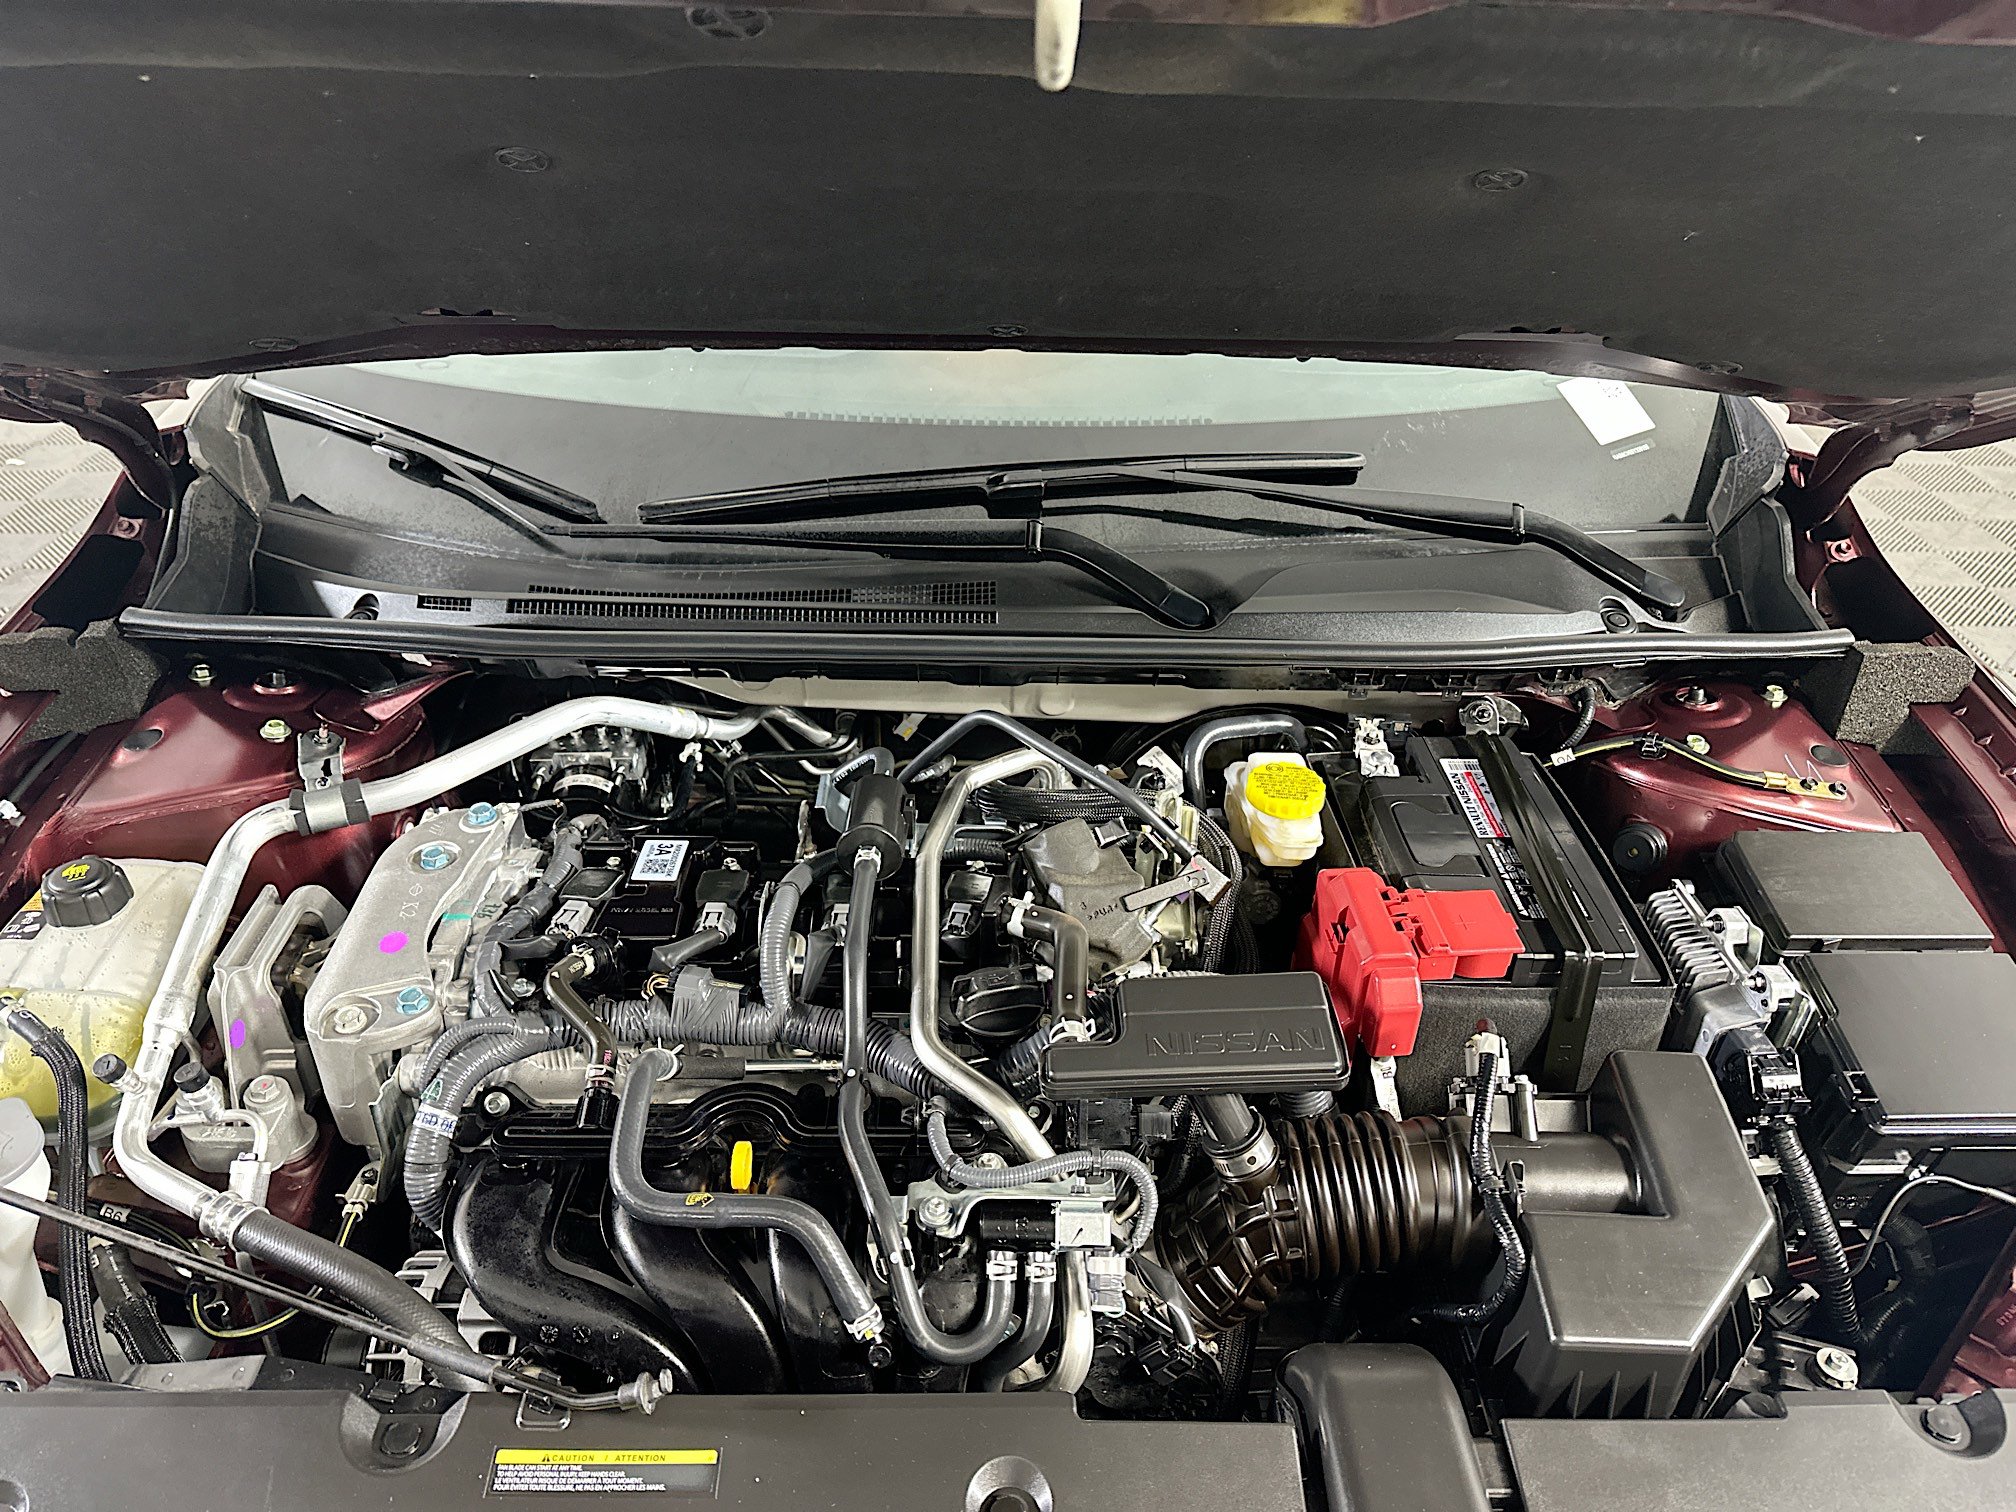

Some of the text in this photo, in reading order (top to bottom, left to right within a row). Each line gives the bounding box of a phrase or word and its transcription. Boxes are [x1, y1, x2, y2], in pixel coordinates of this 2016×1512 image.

[1450, 772, 1473, 805] NISSAN
[1466, 805, 1490, 836] RENAULT
[653, 843, 675, 857] 3A
[1145, 1026, 1326, 1057] NISSAN
[101, 1206, 124, 1221] B6
[552, 1454, 595, 1462] CAUTION
[614, 1454, 666, 1462] ATTENTION
